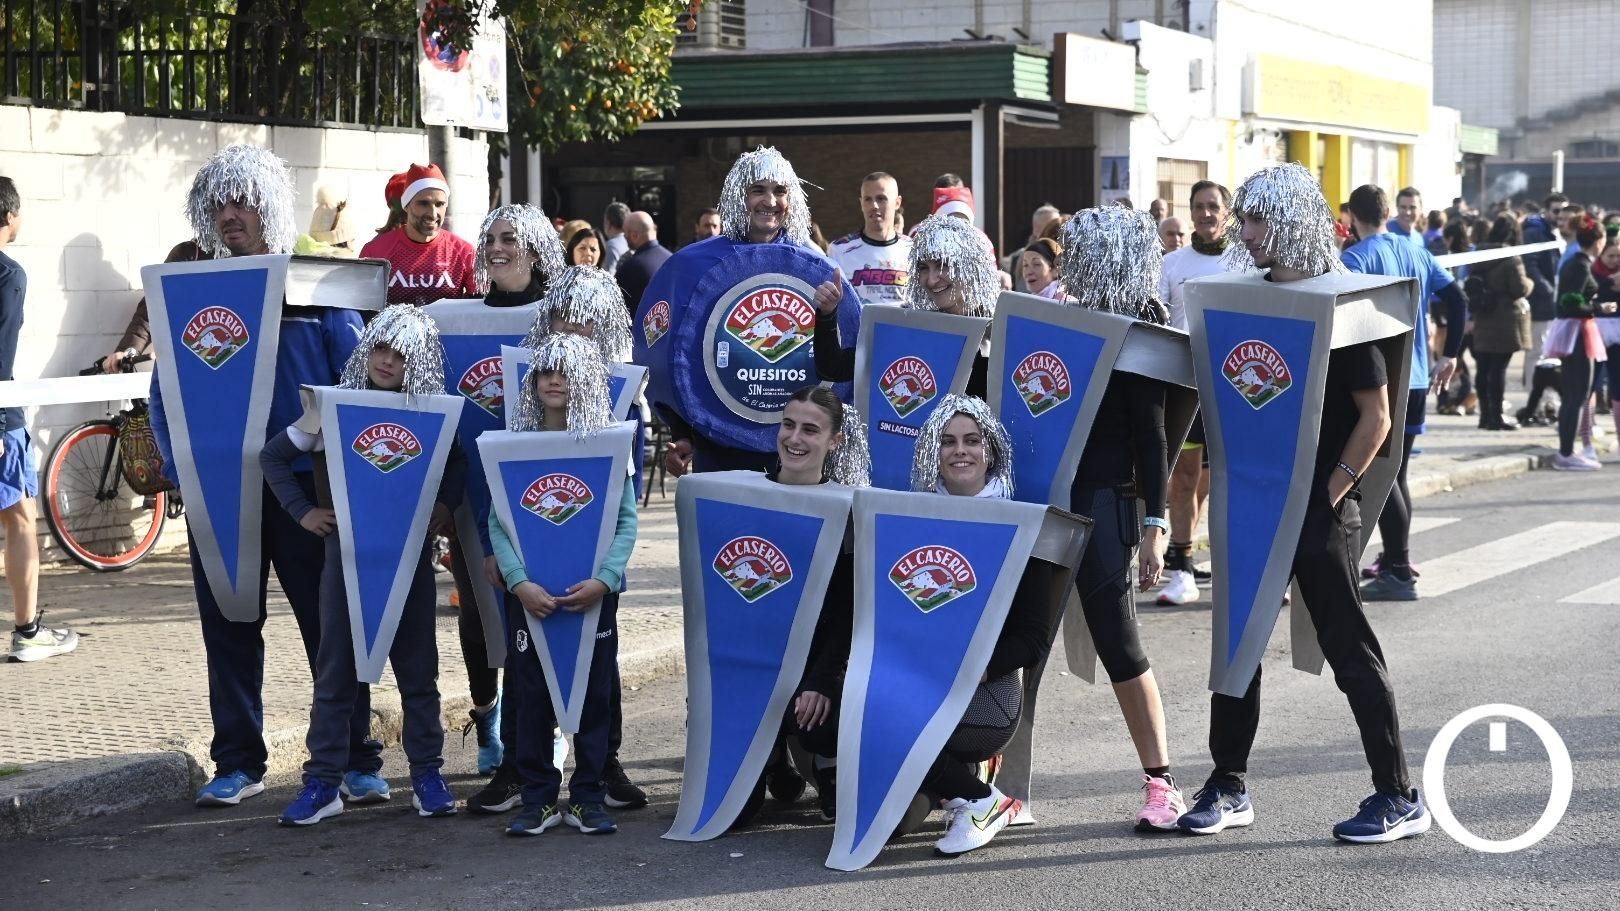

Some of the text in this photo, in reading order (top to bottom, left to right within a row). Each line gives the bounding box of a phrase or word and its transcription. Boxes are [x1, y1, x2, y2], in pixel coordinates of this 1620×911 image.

[388, 269, 456, 289] ALUA
[732, 292, 813, 326] EL CASERIO
[187, 310, 243, 338] EL CASERIO
[736, 368, 807, 381] QUESITOS
[1019, 355, 1067, 390] EL CASERIO
[1228, 344, 1285, 378] EL CASERIO
[465, 371, 483, 388] EL
[884, 360, 933, 390] EL CASERIO
[748, 383, 762, 396] SIN
[359, 426, 417, 450] EL CASERIO
[880, 421, 919, 437] SIN LACTOSA
[526, 476, 587, 502] EL CASERIO
[720, 540, 786, 573] EL CASERIO
[898, 549, 970, 582] EL CASERIO
